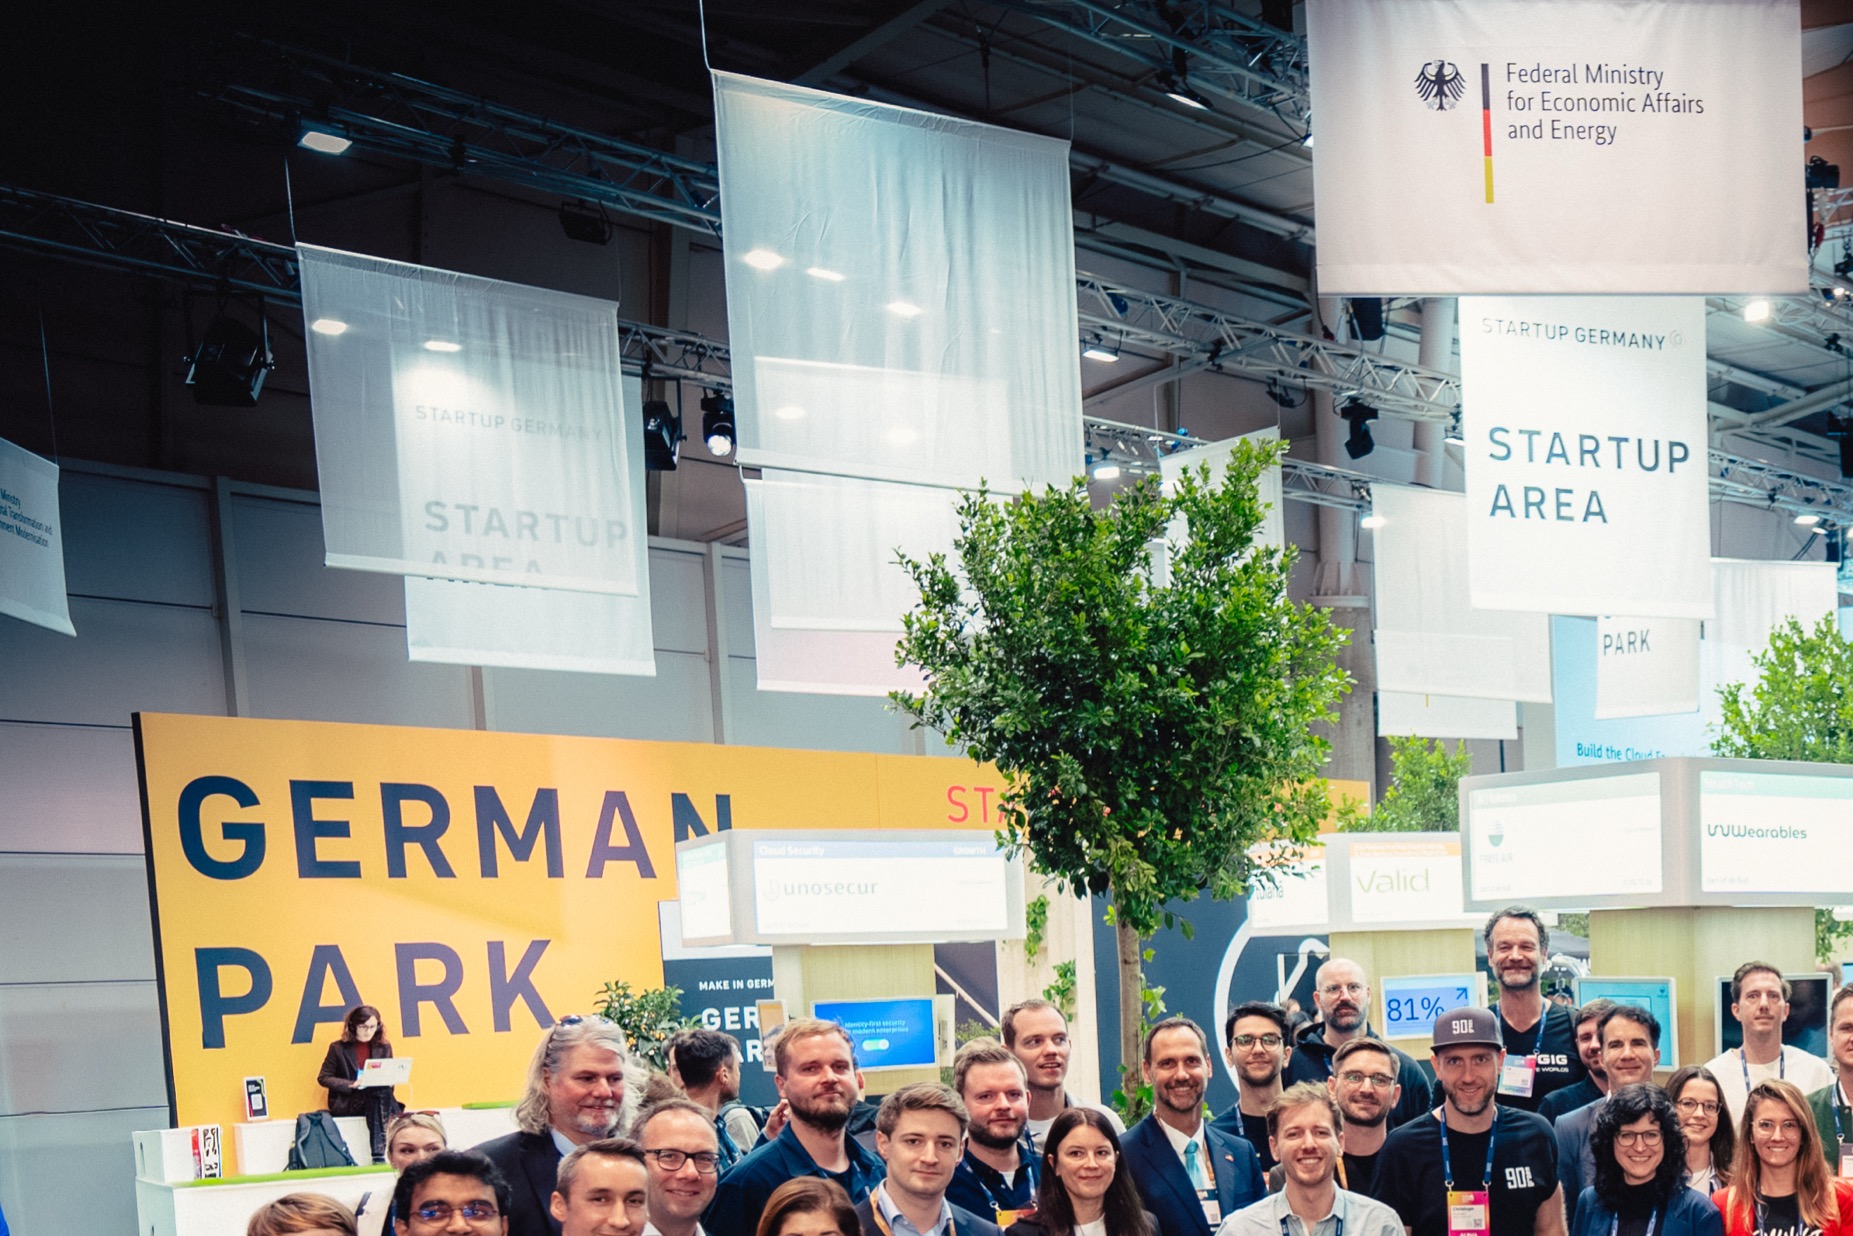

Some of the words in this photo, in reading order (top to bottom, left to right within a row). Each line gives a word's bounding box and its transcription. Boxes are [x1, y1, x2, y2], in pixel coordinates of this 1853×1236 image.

[1506, 62, 1579, 84] Federal
[1585, 63, 1664, 91] Ministry
[1506, 90, 1535, 112] for
[1541, 91, 1636, 112] Economic
[1641, 92, 1705, 114] Affairs
[1507, 119, 1543, 140] and
[1551, 119, 1617, 146] Energy
[1482, 317, 1569, 341] STARTUP
[1574, 326, 1666, 350] GERMANY
[415, 405, 505, 429] STARTUP
[1488, 426, 1690, 474] STARTUP
[1489, 483, 1608, 524] AREA
[424, 501, 628, 549] STARTUP
[1603, 628, 1651, 657] PARK
[1576, 742, 1603, 759] Build
[1605, 745, 1622, 761] the
[783, 880, 880, 897] unosecur
[194, 939, 557, 1050] PARK
[699, 980, 730, 991] MAKE
[732, 979, 745, 990] IN
[1387, 996, 1446, 1022] 81%
